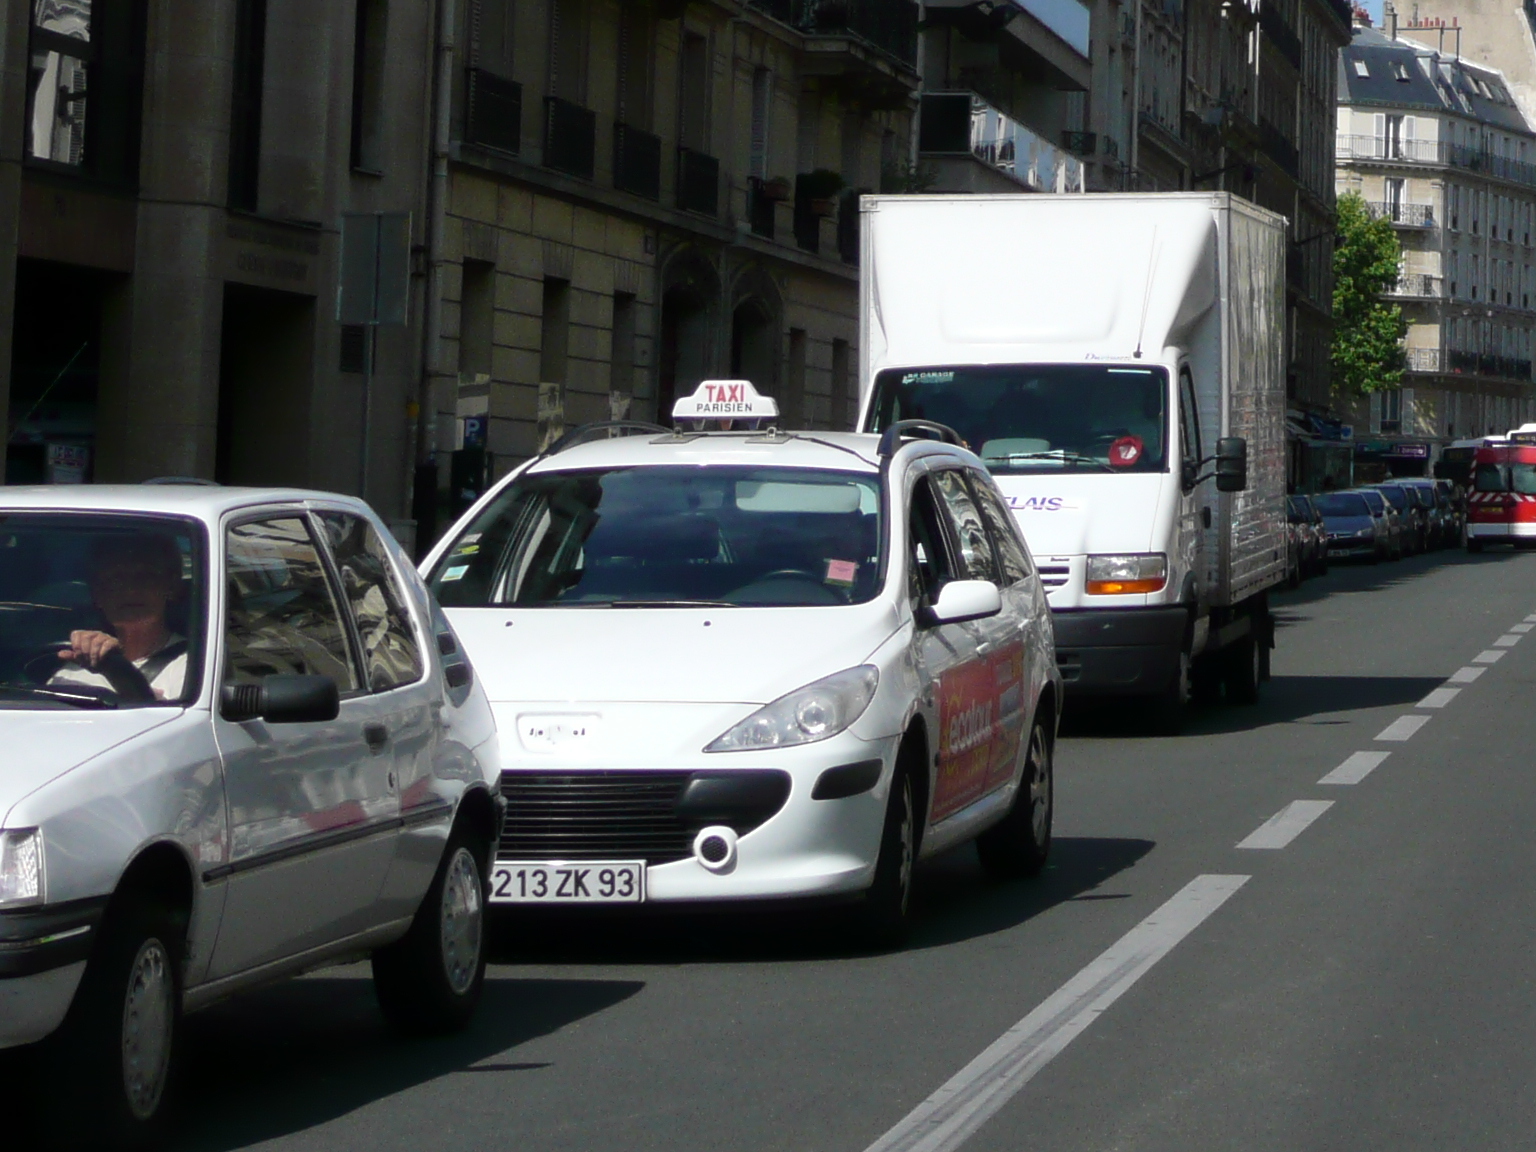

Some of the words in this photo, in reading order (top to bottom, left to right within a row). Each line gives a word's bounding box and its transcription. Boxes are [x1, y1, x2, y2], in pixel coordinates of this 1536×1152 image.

[705, 384, 745, 403] TAXI
[696, 403, 753, 413] PARISIEN
[465, 419, 480, 437] P
[488, 869, 549, 898] 213
[555, 869, 592, 898] ZK
[598, 868, 635, 898] 93
